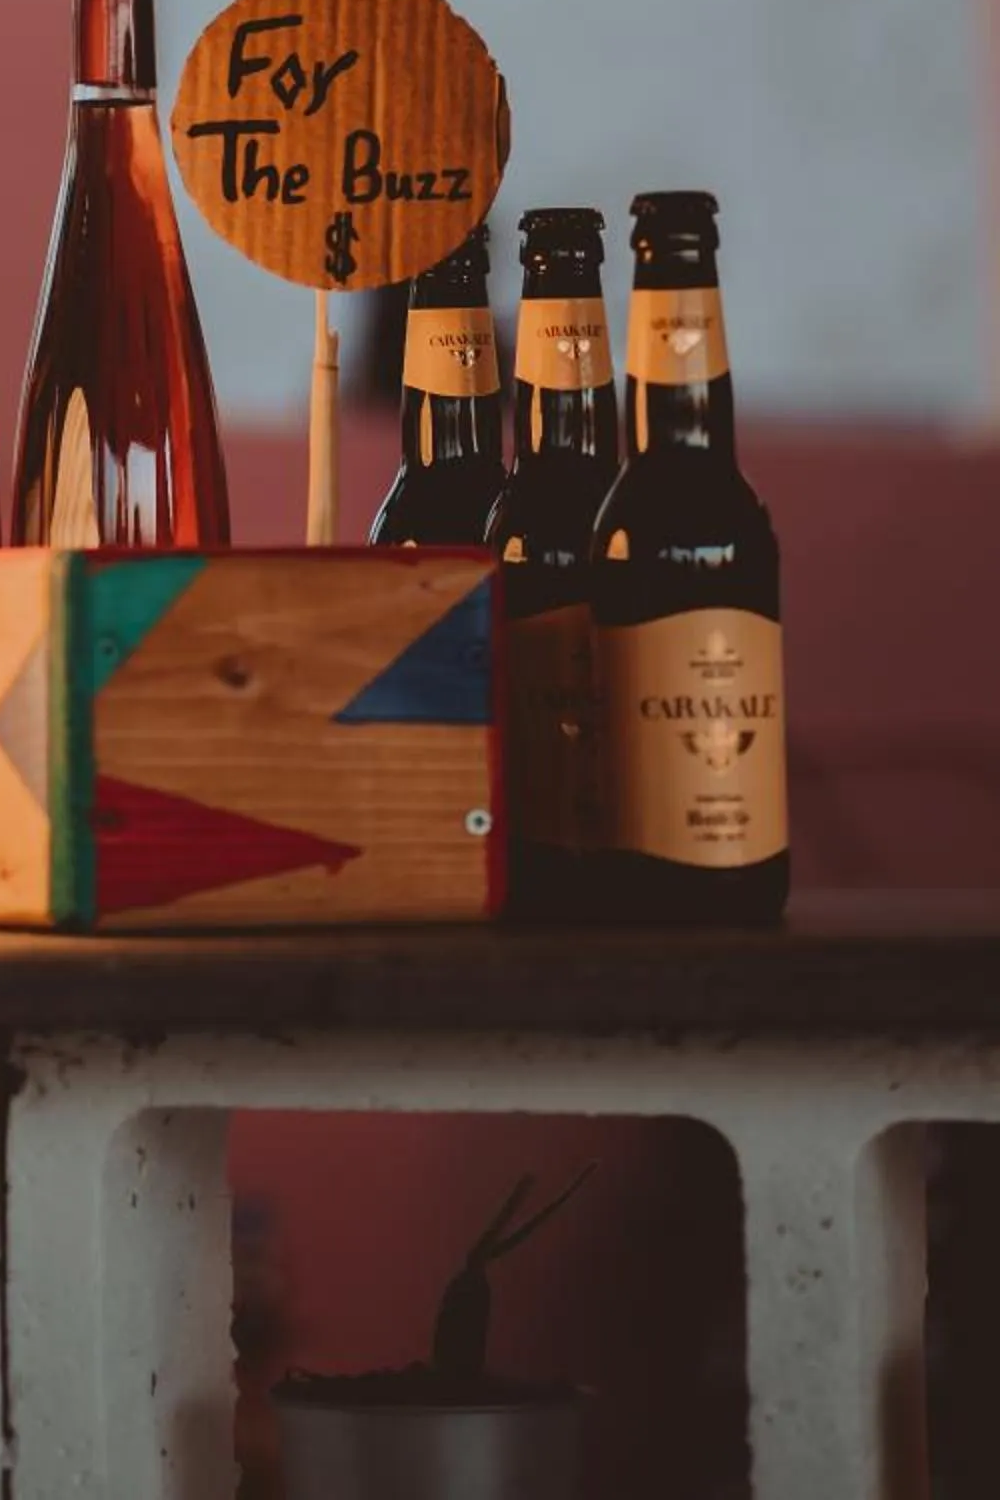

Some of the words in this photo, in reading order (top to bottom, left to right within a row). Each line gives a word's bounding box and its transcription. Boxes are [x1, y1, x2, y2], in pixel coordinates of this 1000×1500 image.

[228, 15, 358, 116] For
[187, 120, 309, 203] The
[342, 130, 472, 202] Buzz
[640, 694, 776, 721] CARAKALE
